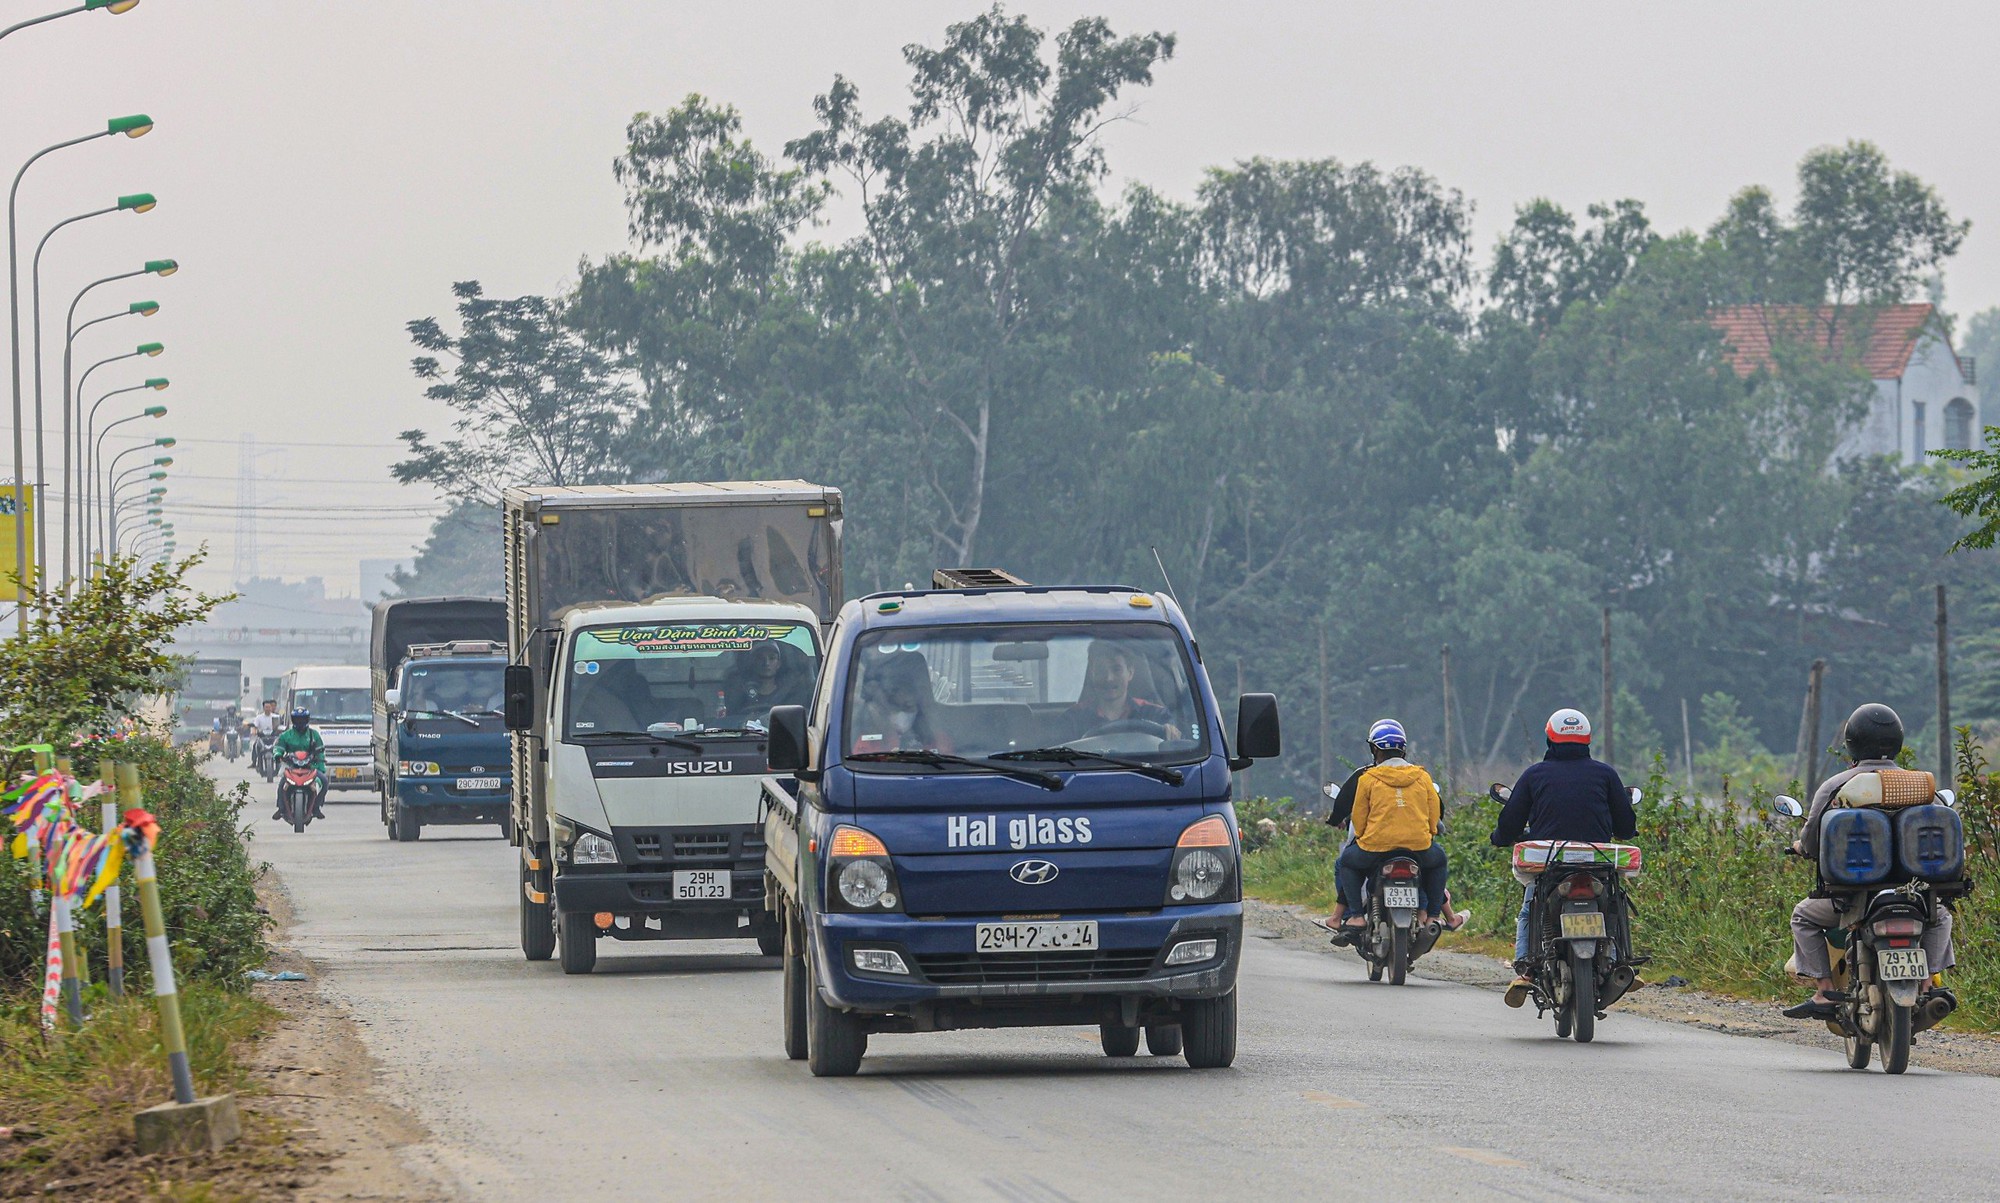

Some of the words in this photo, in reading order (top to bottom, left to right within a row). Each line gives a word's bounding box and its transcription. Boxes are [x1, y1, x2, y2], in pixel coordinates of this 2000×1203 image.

[621, 629, 652, 641] Vạn
[658, 628, 695, 640] Dặm
[701, 626, 737, 638] Bình
[741, 626, 765, 637] An
[667, 761, 733, 774] ISUZU
[948, 815, 996, 847] Hal
[1009, 814, 1092, 849] glass
[690, 872, 714, 884] 29H
[679, 886, 724, 897] 501.23
[1389, 888, 1412, 897] 29-X1
[1885, 951, 1919, 964] 29-X1
[1884, 965, 1925, 978] 402.80
